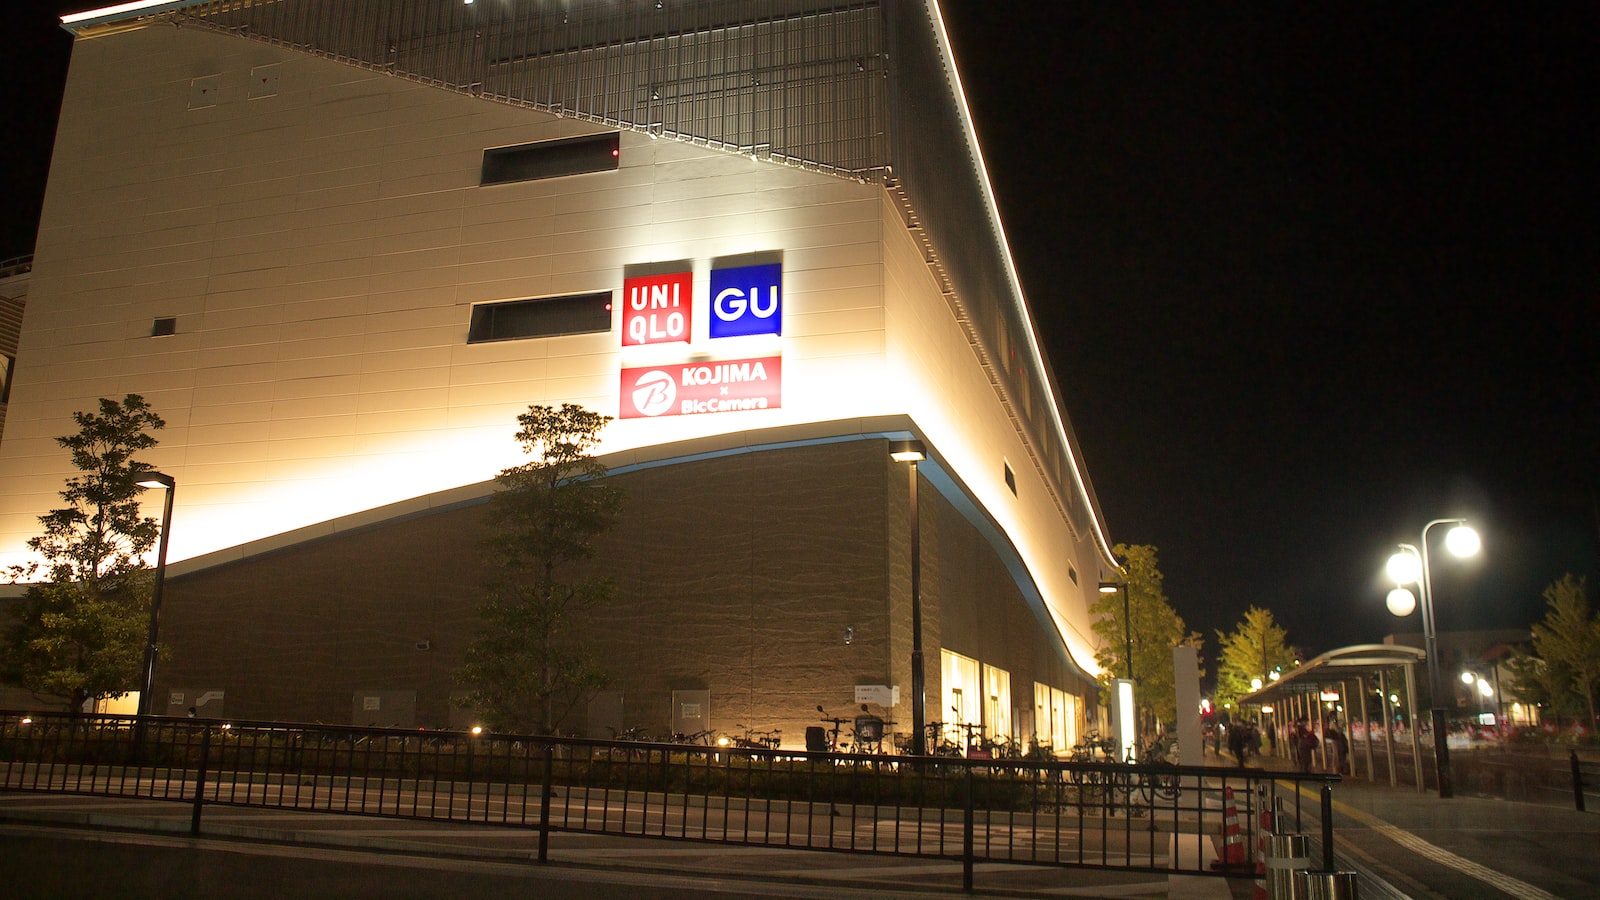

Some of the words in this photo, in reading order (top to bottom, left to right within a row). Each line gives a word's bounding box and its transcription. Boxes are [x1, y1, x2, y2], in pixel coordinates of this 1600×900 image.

[631, 283, 680, 311] UNI
[713, 285, 778, 322] GU
[629, 312, 684, 344] QLO
[681, 362, 768, 386] KOJIMA
[681, 397, 768, 414] BicCamera
